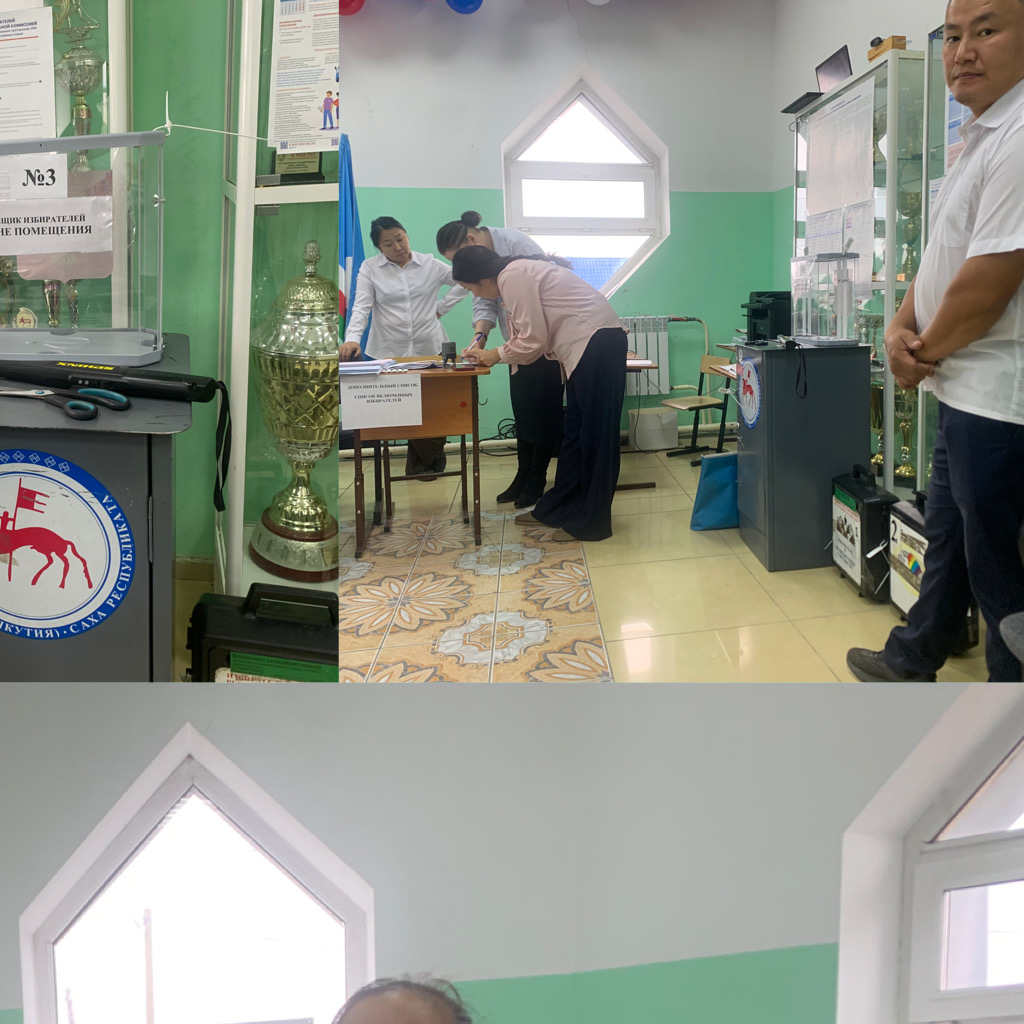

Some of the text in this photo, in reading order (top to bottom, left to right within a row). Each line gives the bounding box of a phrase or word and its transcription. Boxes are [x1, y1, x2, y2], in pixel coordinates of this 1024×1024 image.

[22, 168, 56, 187] №3
[23, 213, 86, 224] ИЗБИРАТЕЛЕЙ
[14, 225, 92, 237] ПОМЕЩЕНИЯ
[56, 361, 115, 371] SPHINX
[69, 610, 107, 634] САХА
